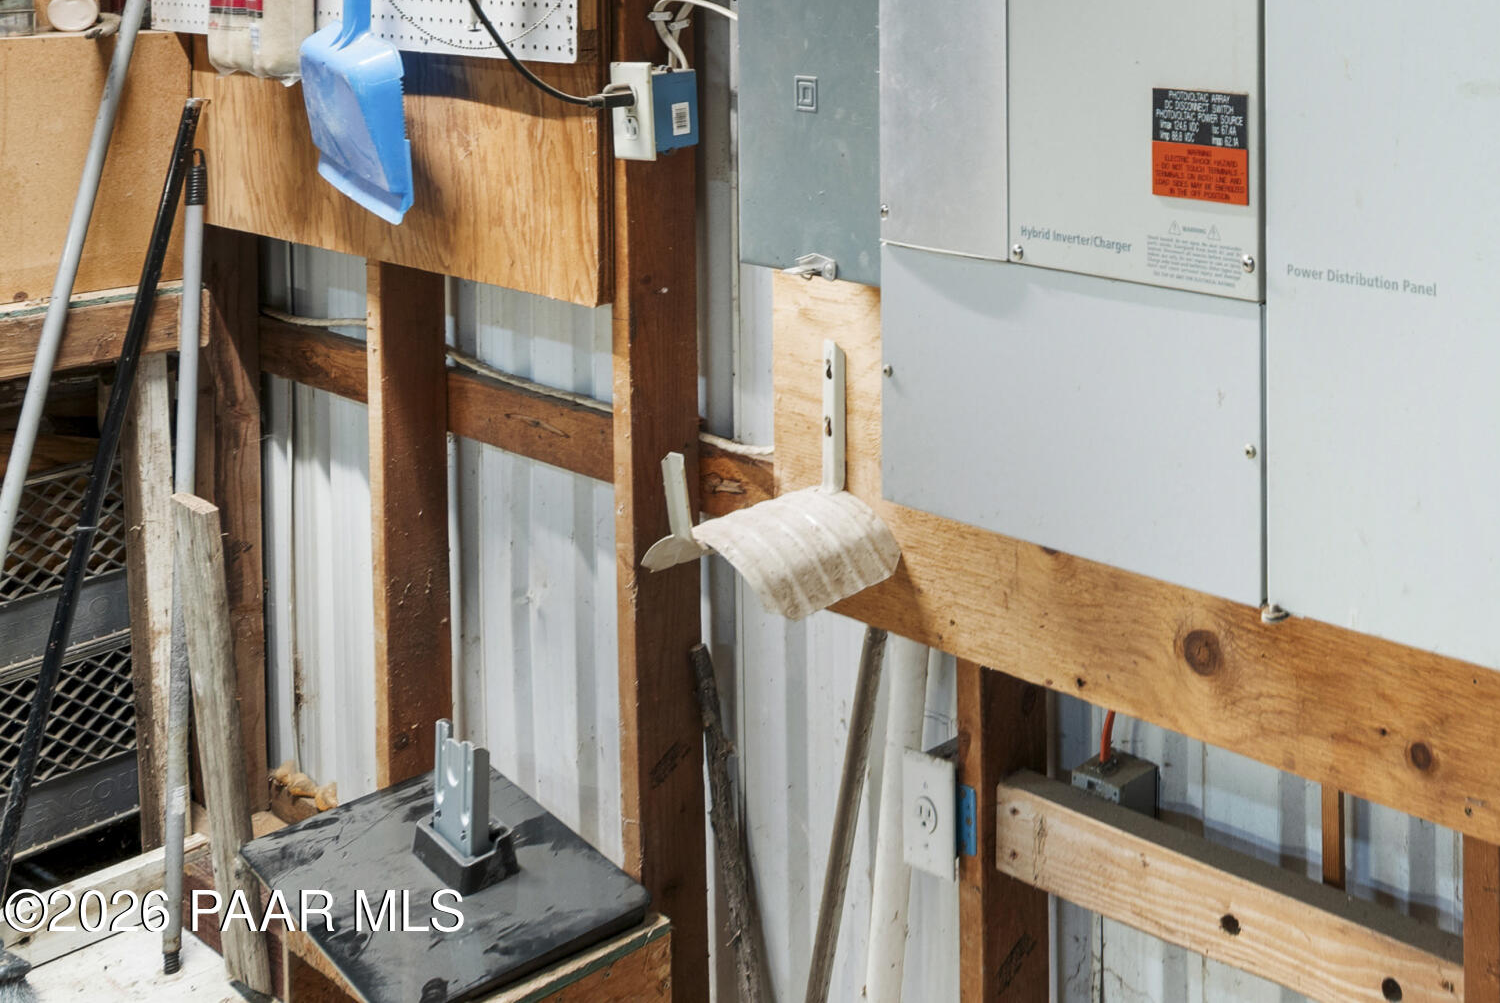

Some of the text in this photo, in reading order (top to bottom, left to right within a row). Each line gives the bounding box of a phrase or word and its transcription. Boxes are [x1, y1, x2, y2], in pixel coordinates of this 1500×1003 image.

[1168, 90, 1230, 104] PHOTOVOLTAIC ARRAY
[1164, 99, 1234, 115] DC DISCONNECT SWITCH
[1156, 108, 1243, 126] PHOTOVOLTAIC POWER SOURCE
[1020, 225, 1132, 254] Hybrid Inverter/Charger
[1287, 263, 1437, 297] Power Distribution Panel
